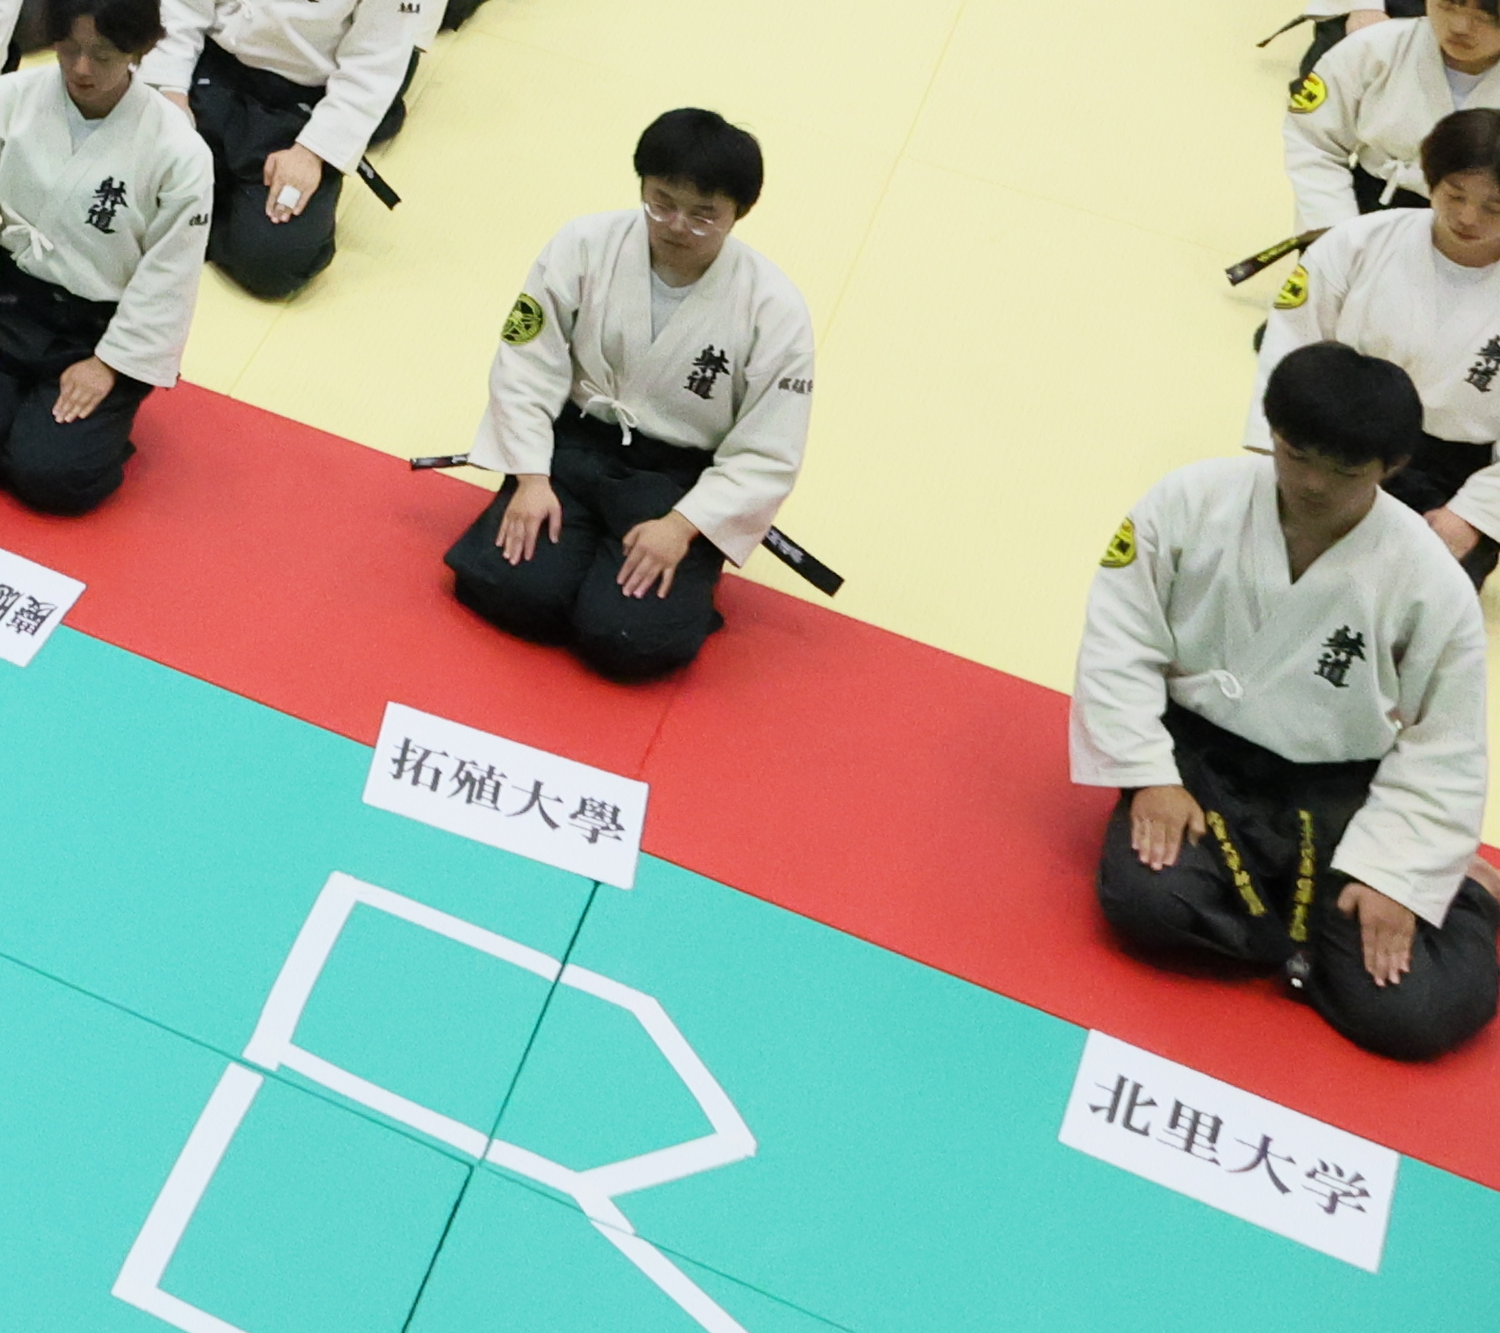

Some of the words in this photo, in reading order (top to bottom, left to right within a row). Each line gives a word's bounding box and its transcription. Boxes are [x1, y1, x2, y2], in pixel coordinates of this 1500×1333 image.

[85, 176, 128, 234] 躰道
[684, 345, 728, 401] 躰道
[1314, 625, 1366, 688] 躰道
[388, 735, 629, 848] 拓殖大學
[1085, 1072, 1374, 1221] 北里大学
